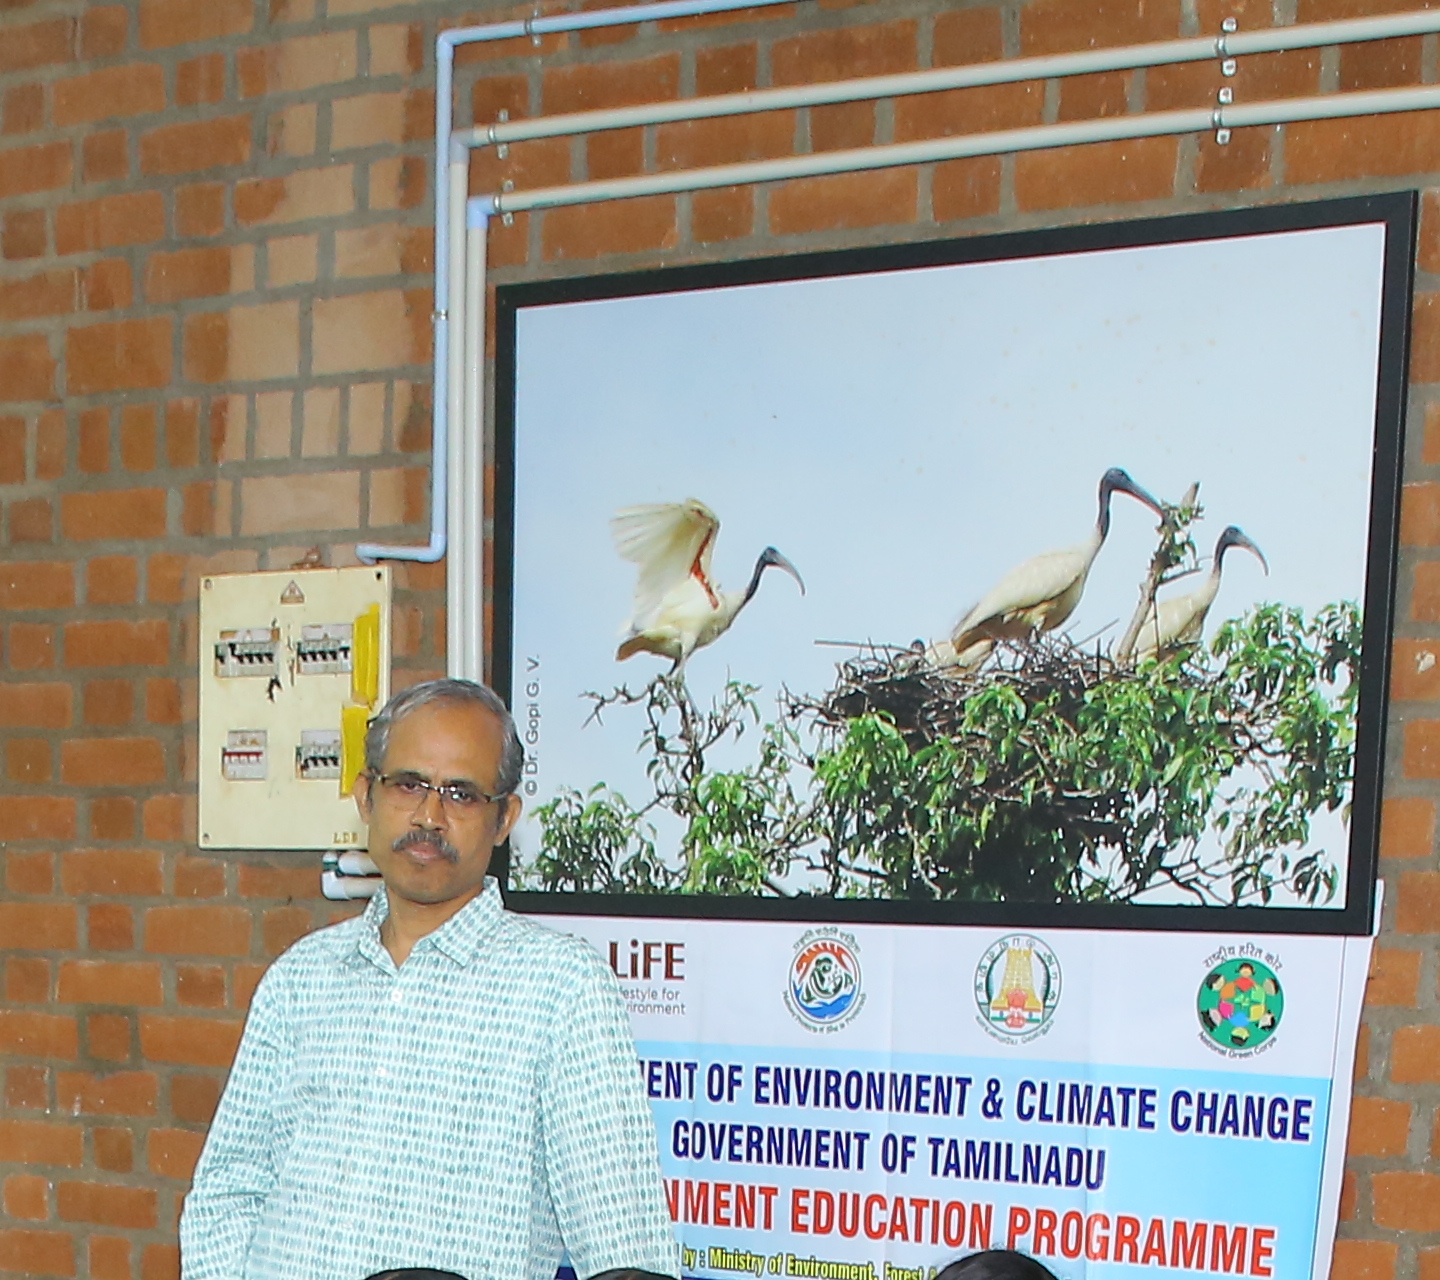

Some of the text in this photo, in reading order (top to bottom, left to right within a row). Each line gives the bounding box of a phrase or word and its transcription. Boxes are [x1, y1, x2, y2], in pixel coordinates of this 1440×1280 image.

[526, 653, 540, 672] V.
[526, 677, 540, 698] G.
[526, 703, 541, 745] Gopi
[525, 751, 538, 775] Dr.
[609, 938, 686, 980] LiFE
[662, 986, 680, 1000] for
[1197, 1030, 1278, 1059] National Green Corps
[706, 1062, 743, 1103] OF
[754, 1065, 972, 1117] ENVIRONMENT
[981, 1077, 1003, 1119] &
[1016, 1080, 1157, 1129] CLIMATE
[1170, 1090, 1313, 1142] CHANGE
[672, 1119, 1106, 1190] GOVERNMENT OF TAMILNADU
[791, 1187, 992, 1250] EDUCATION
[1007, 1205, 1276, 1277] PROGRAMME
[708, 1247, 765, 1278] Ministry
[768, 1254, 783, 1275] of
